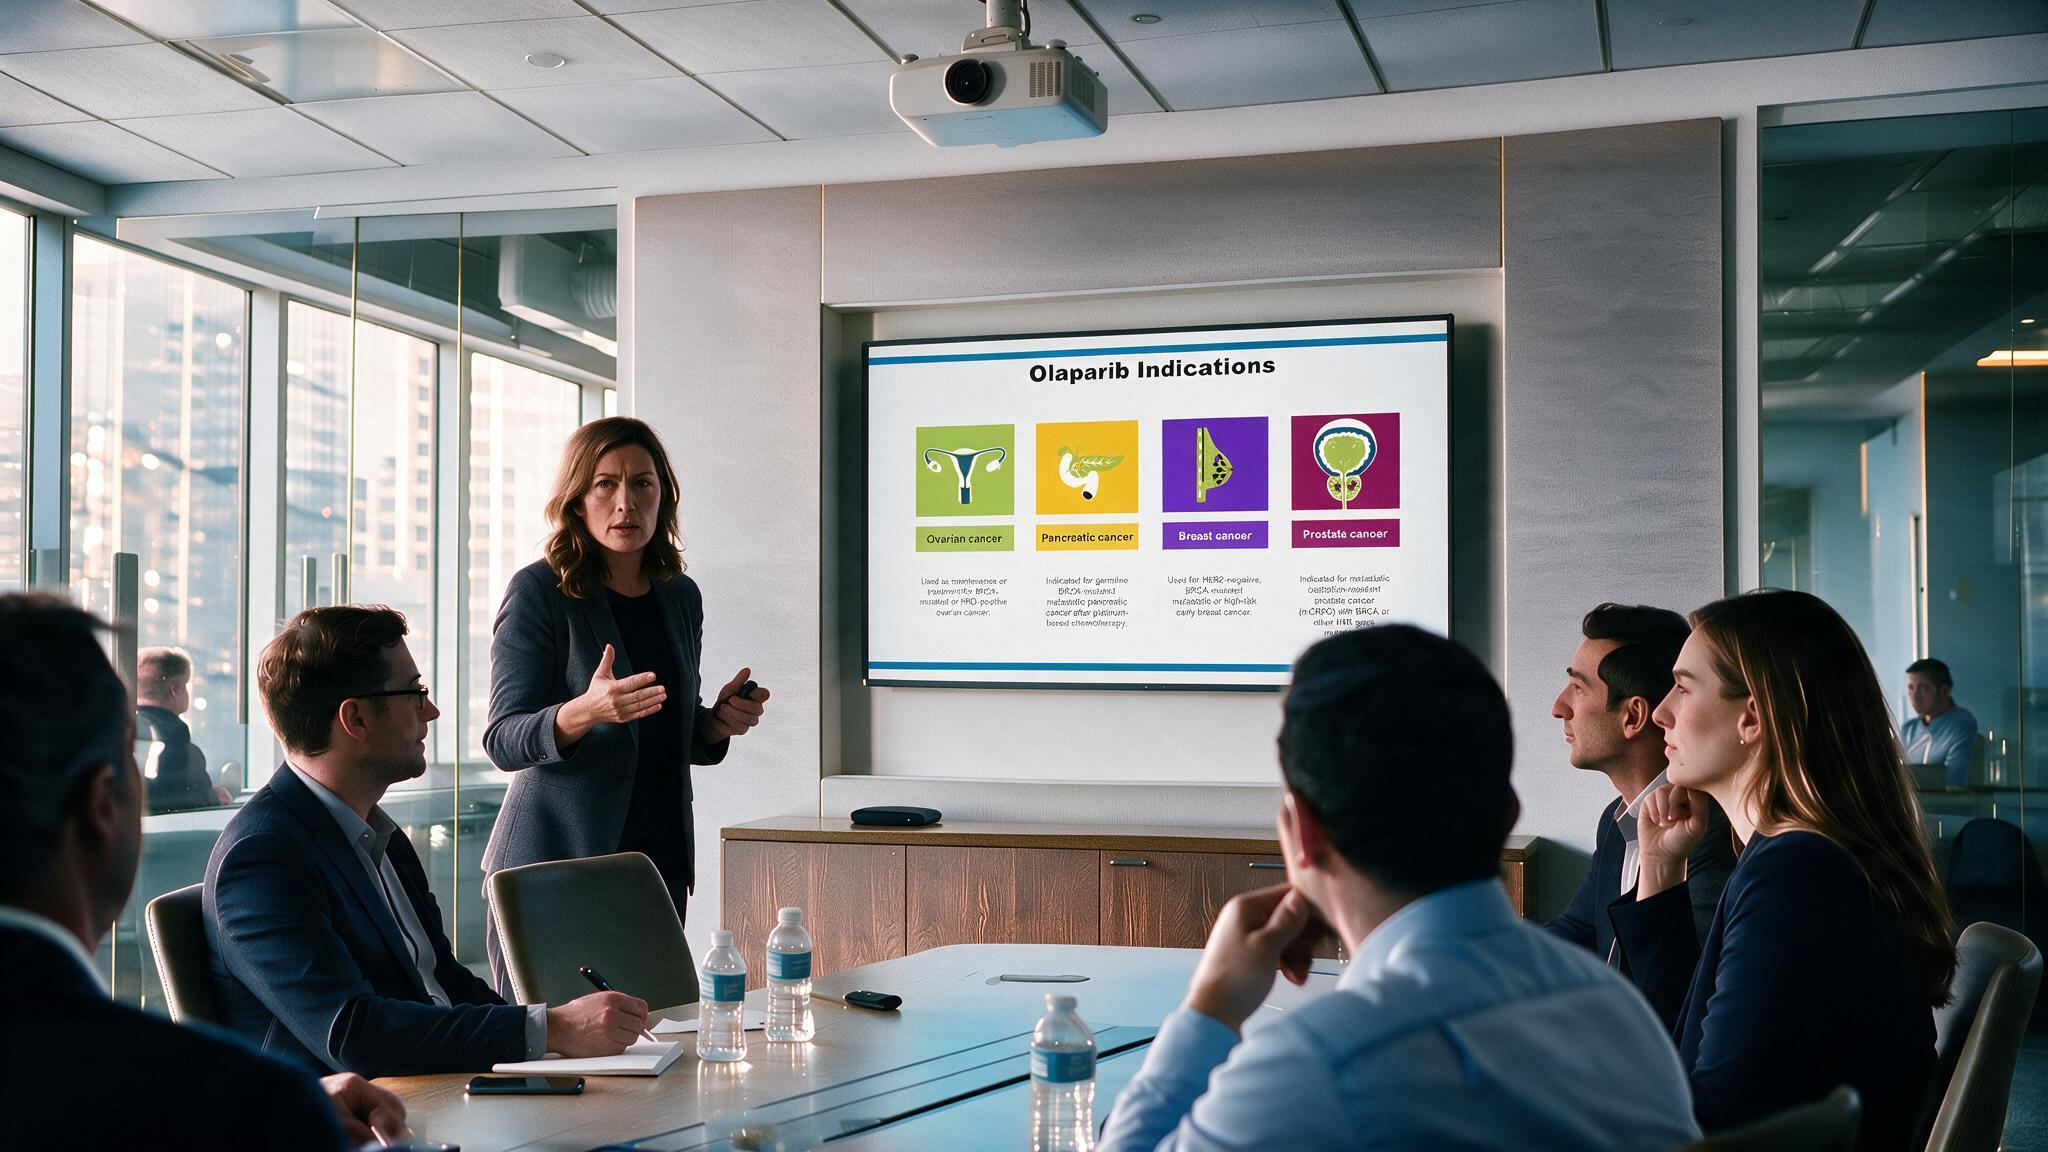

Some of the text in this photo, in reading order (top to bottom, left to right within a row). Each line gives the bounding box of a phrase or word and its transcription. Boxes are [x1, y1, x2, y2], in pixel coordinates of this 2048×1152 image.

[1029, 358, 1276, 384] Olaparib Indications
[927, 534, 1003, 544] Ovarian cancer
[1041, 533, 1134, 543] Pancreatic cancer
[1178, 531, 1213, 541] Breast
[1303, 529, 1347, 540] Prostate
